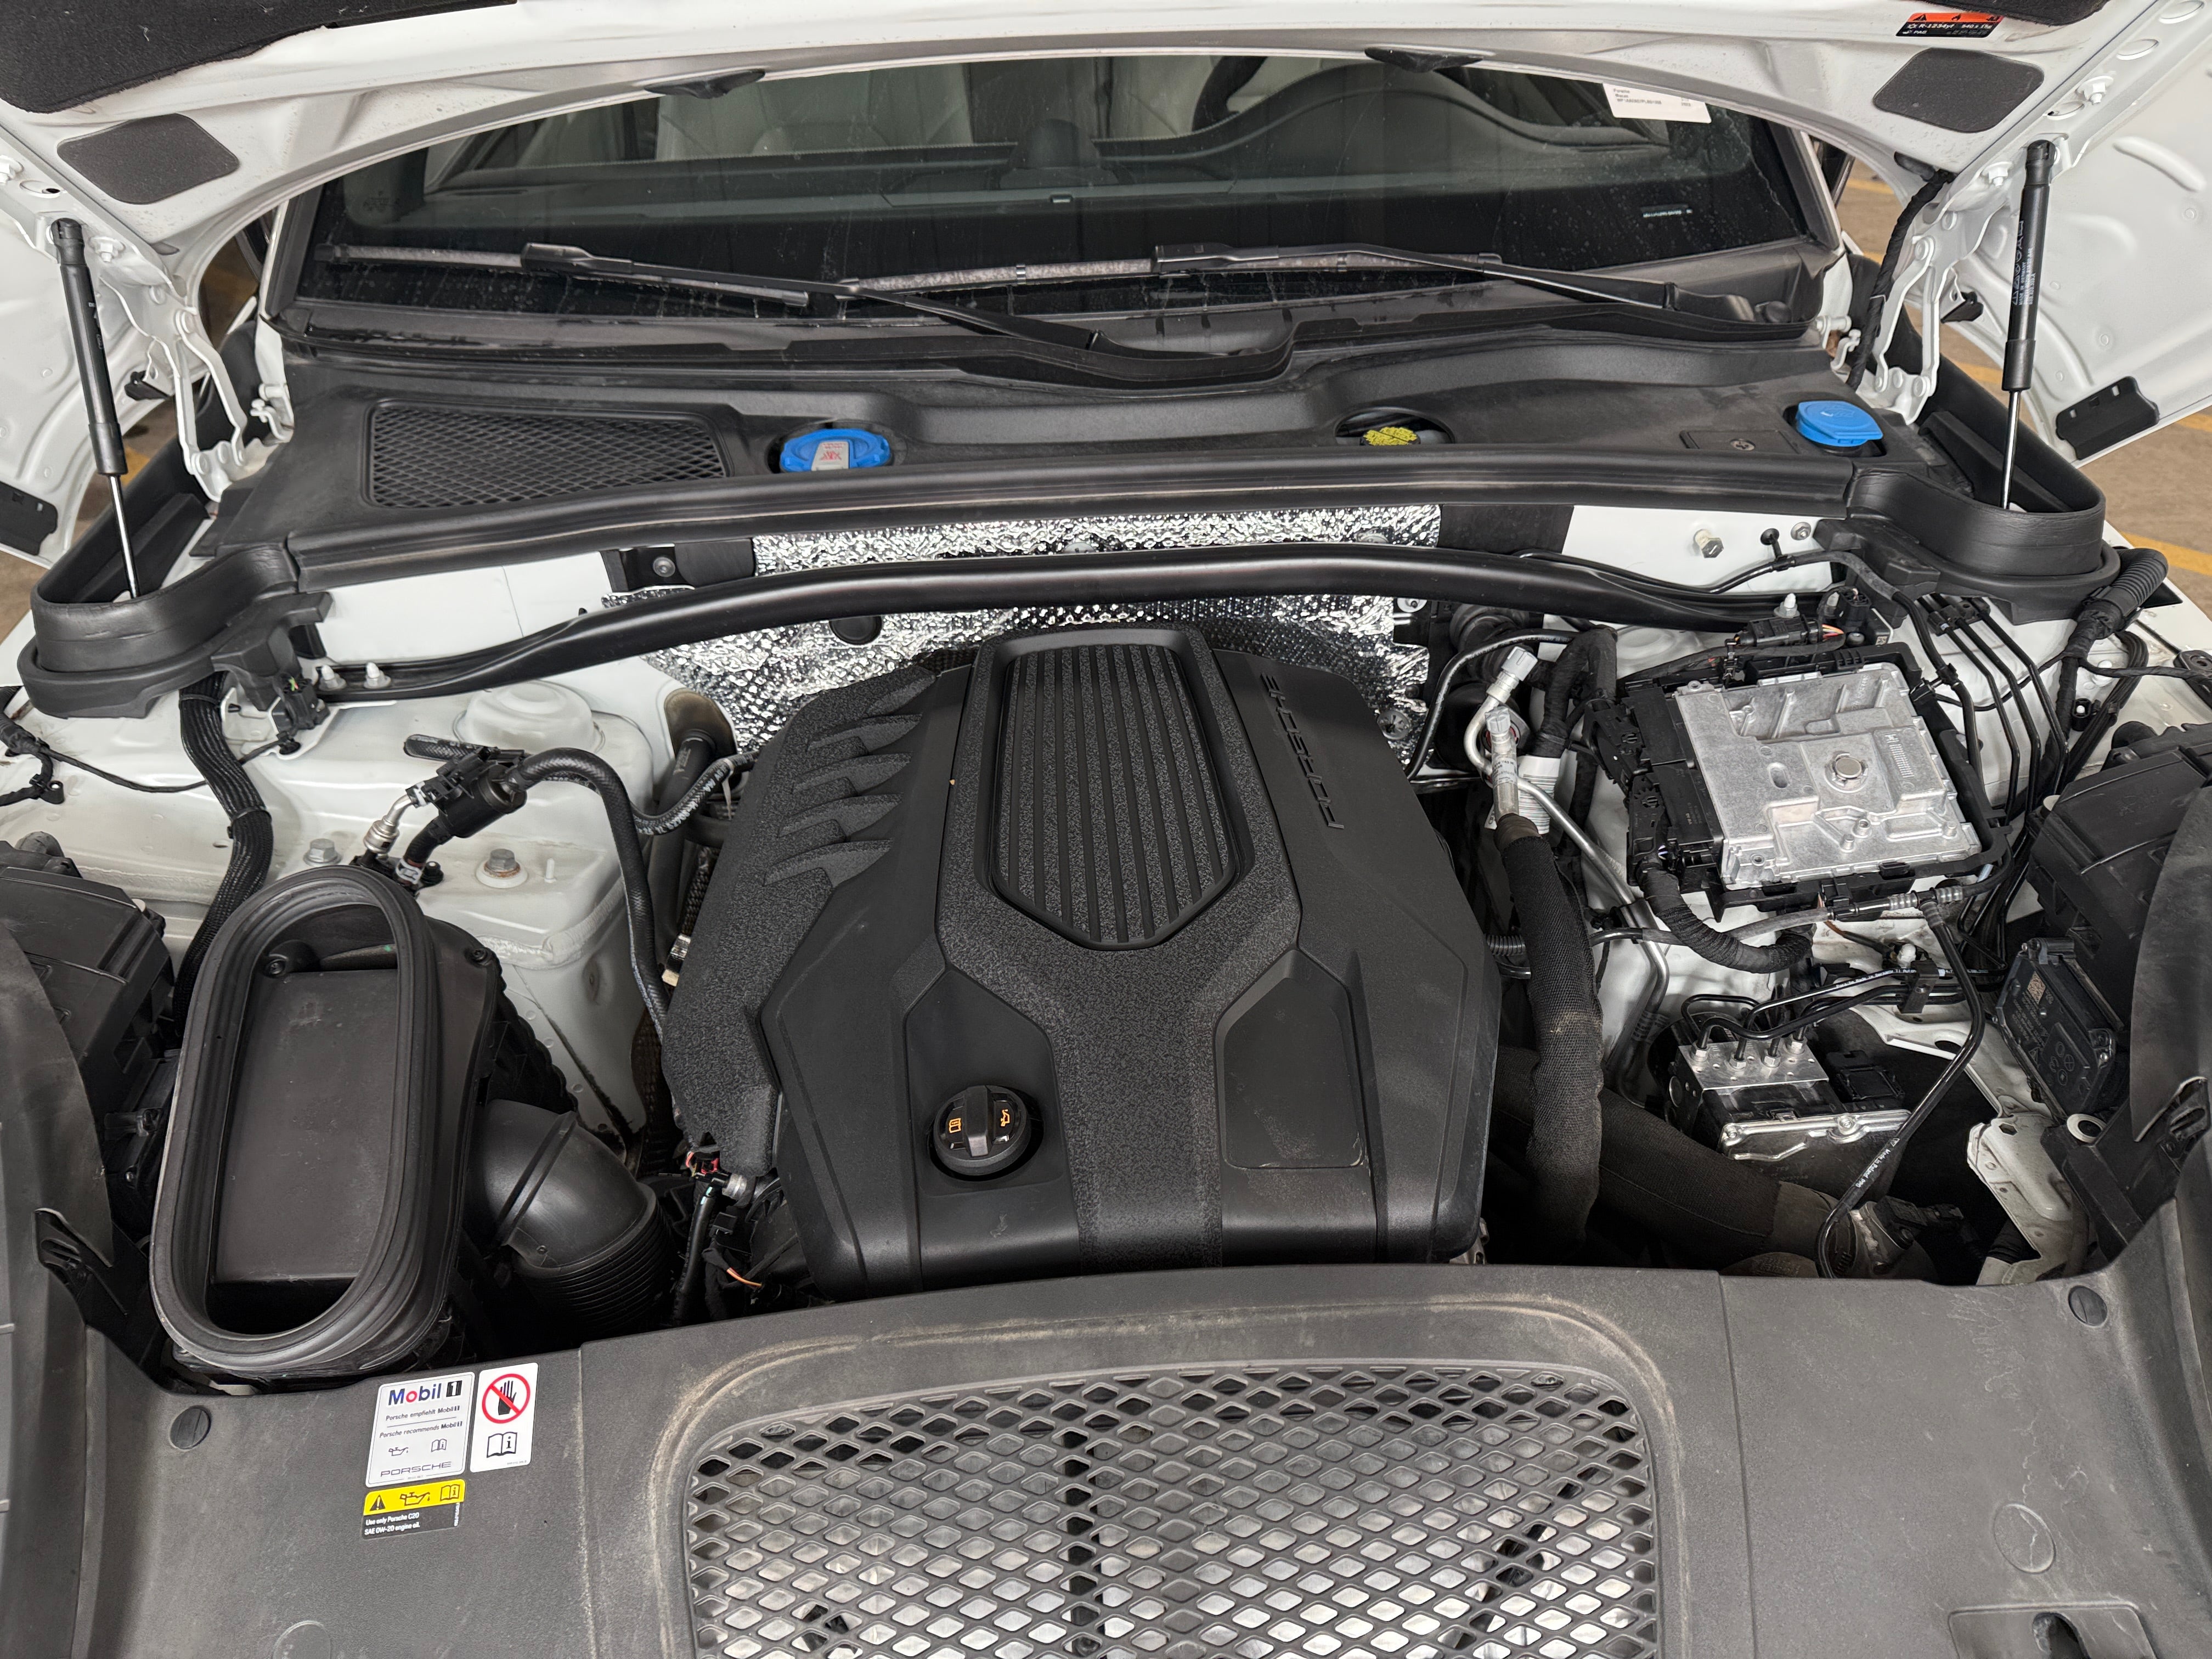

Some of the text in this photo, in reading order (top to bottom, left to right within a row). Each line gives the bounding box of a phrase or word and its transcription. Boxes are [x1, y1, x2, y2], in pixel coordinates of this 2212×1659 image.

[1878, 1149, 1891, 1160] Made
[1863, 1163, 1878, 1179] Poland
[388, 1381, 461, 1406] Mobil 1
[386, 1413, 408, 1421] Porsche
[410, 1409, 436, 1419] empfiehlt
[379, 1430, 402, 1438] Porsche
[403, 1425, 439, 1435] recommends
[380, 1462, 452, 1477] PORSCHE
[376, 1517, 387, 1526] only
[387, 1514, 408, 1523] Porsche
[364, 1527, 375, 1536] SAE
[395, 1523, 412, 1533] engine
[412, 1521, 420, 1529] oil.
